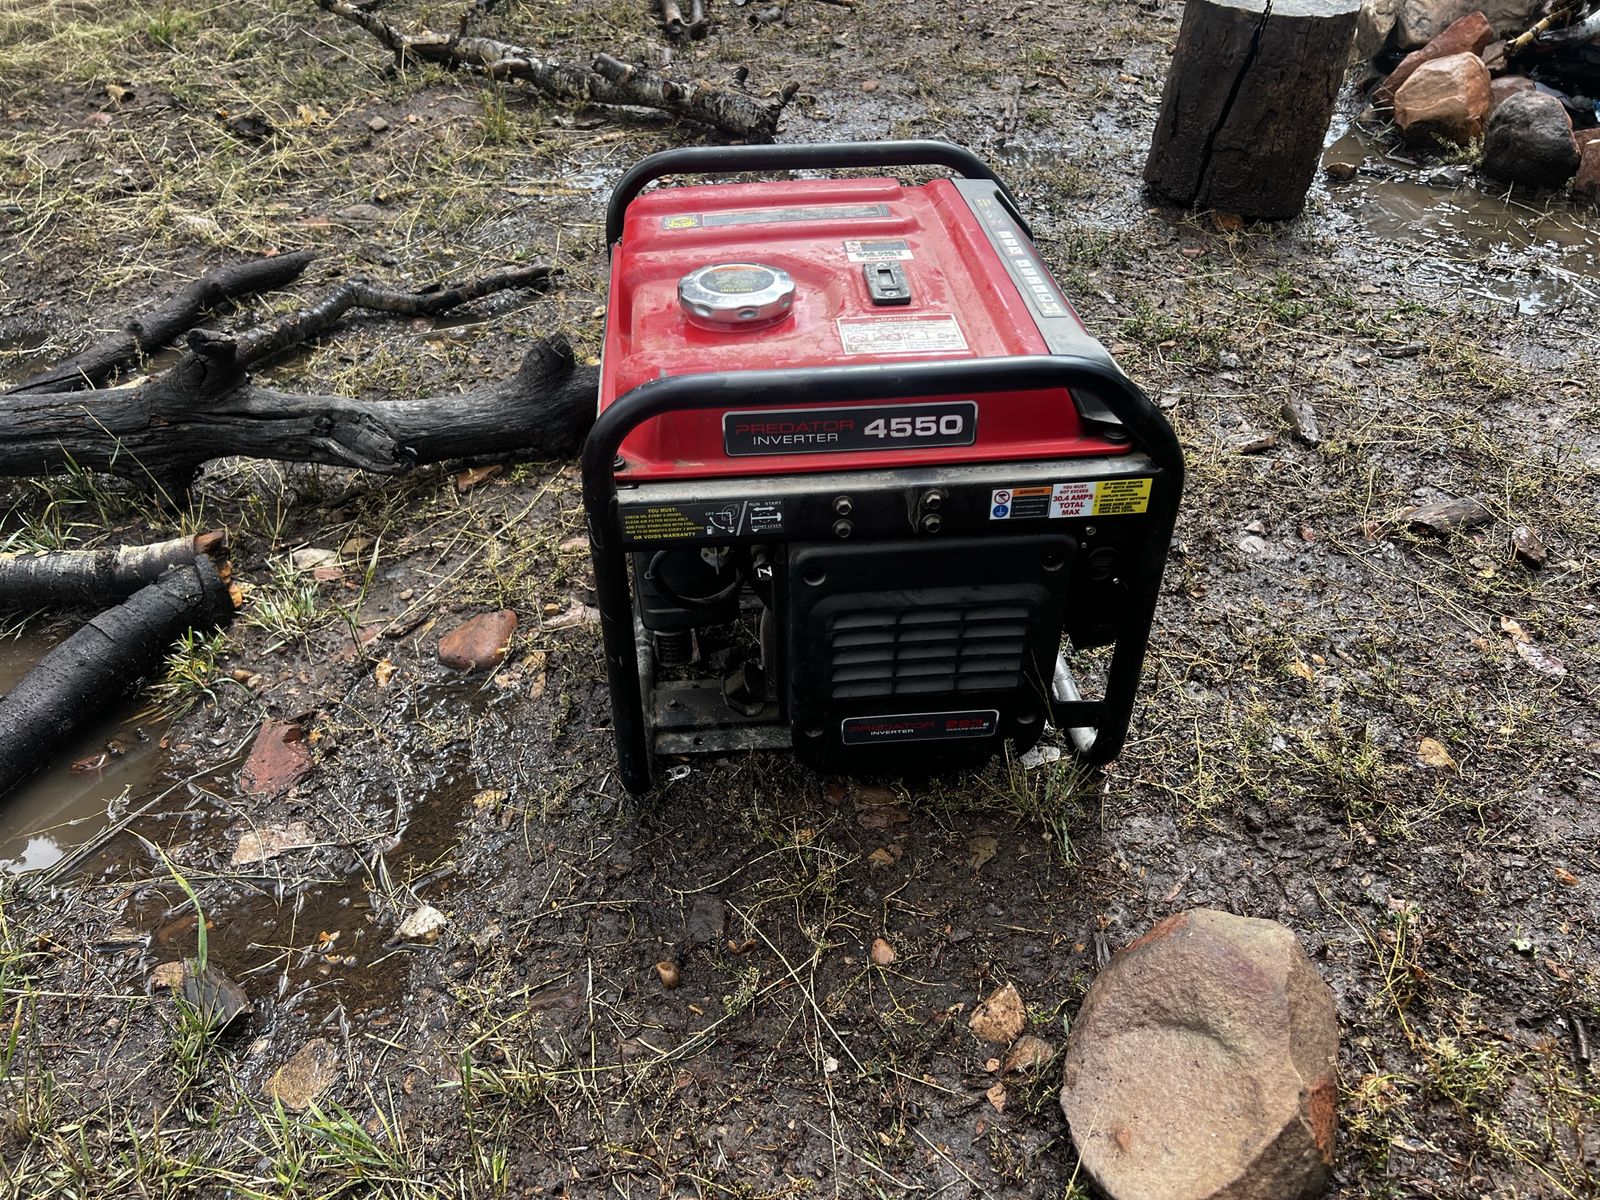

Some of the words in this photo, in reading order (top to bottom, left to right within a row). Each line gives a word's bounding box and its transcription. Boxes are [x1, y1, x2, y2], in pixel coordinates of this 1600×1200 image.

[735, 419, 854, 436] PREDATOR
[863, 415, 963, 439] 4550
[753, 432, 839, 446] INVERTER
[848, 721, 935, 732] PREDATOR
